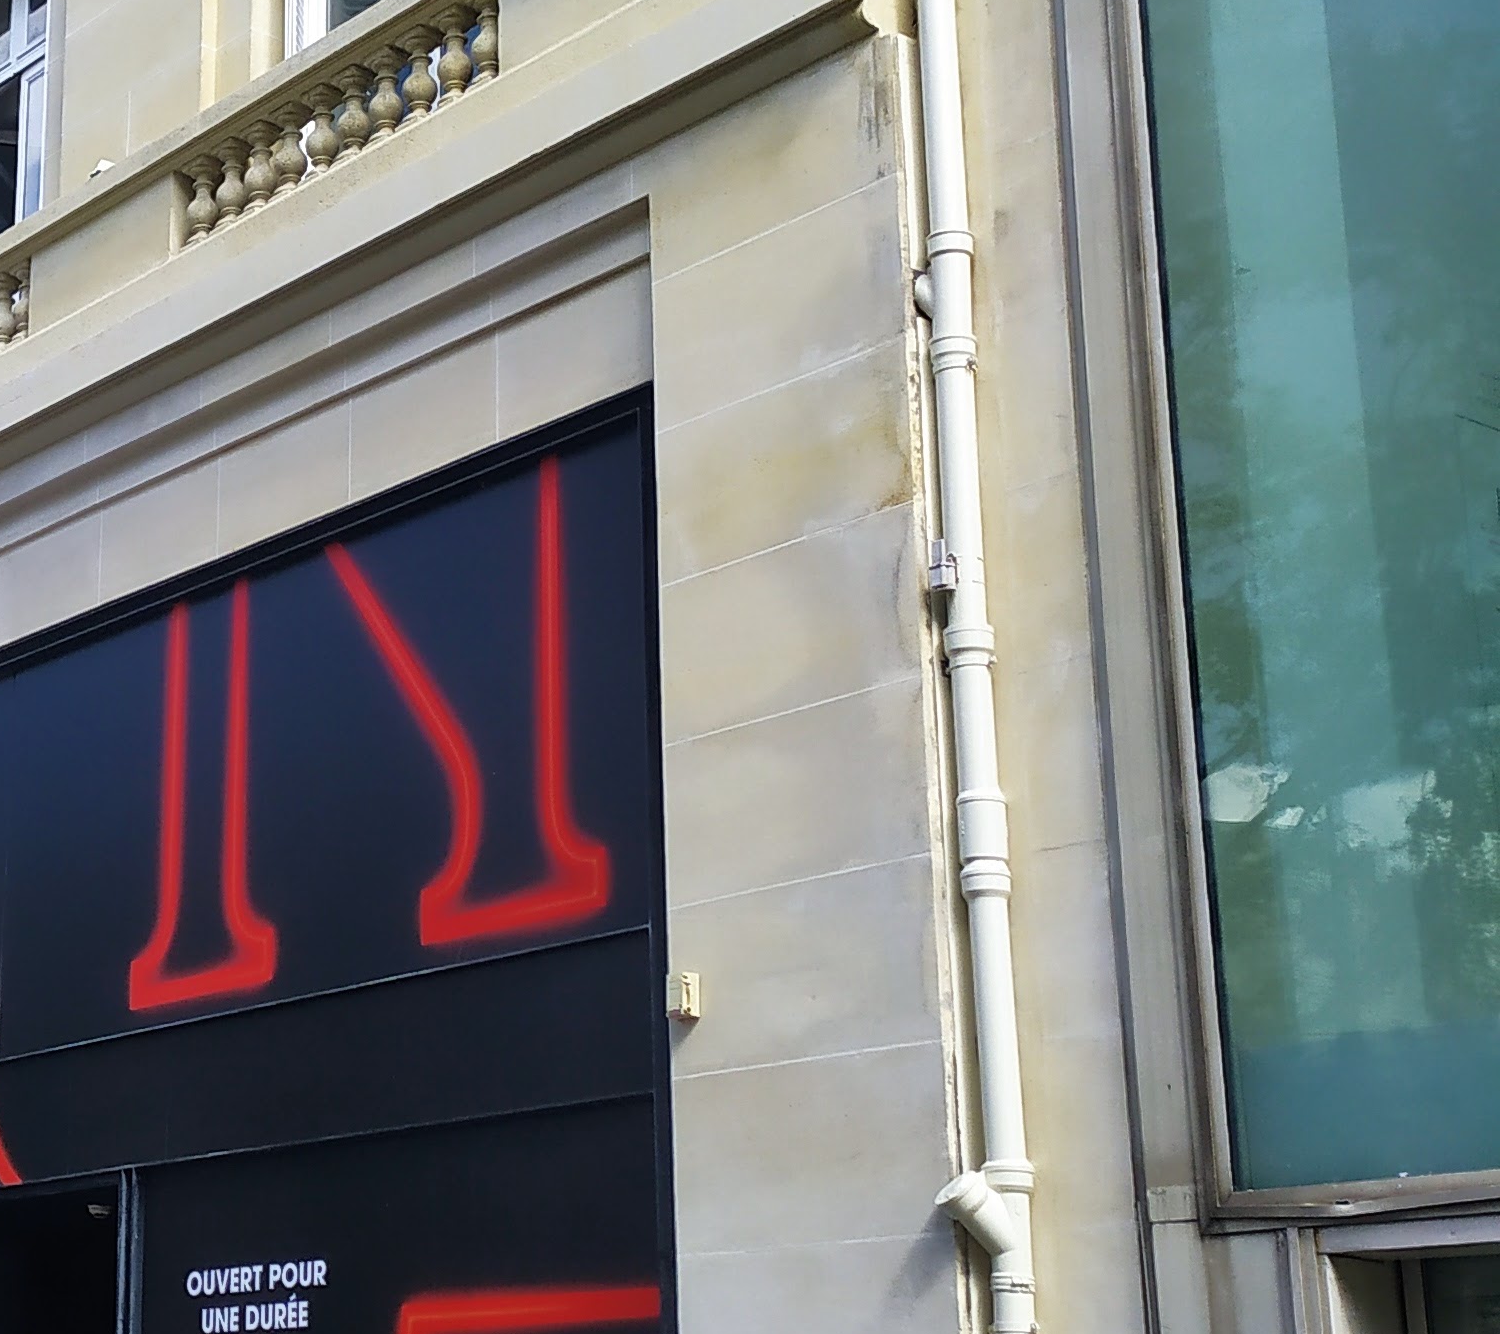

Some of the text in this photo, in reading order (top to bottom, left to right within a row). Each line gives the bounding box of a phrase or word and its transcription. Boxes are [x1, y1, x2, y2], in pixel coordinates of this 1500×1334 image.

[186, 1259, 327, 1297] OUVERT POUR
[201, 1292, 309, 1334] UNE DURÉE
